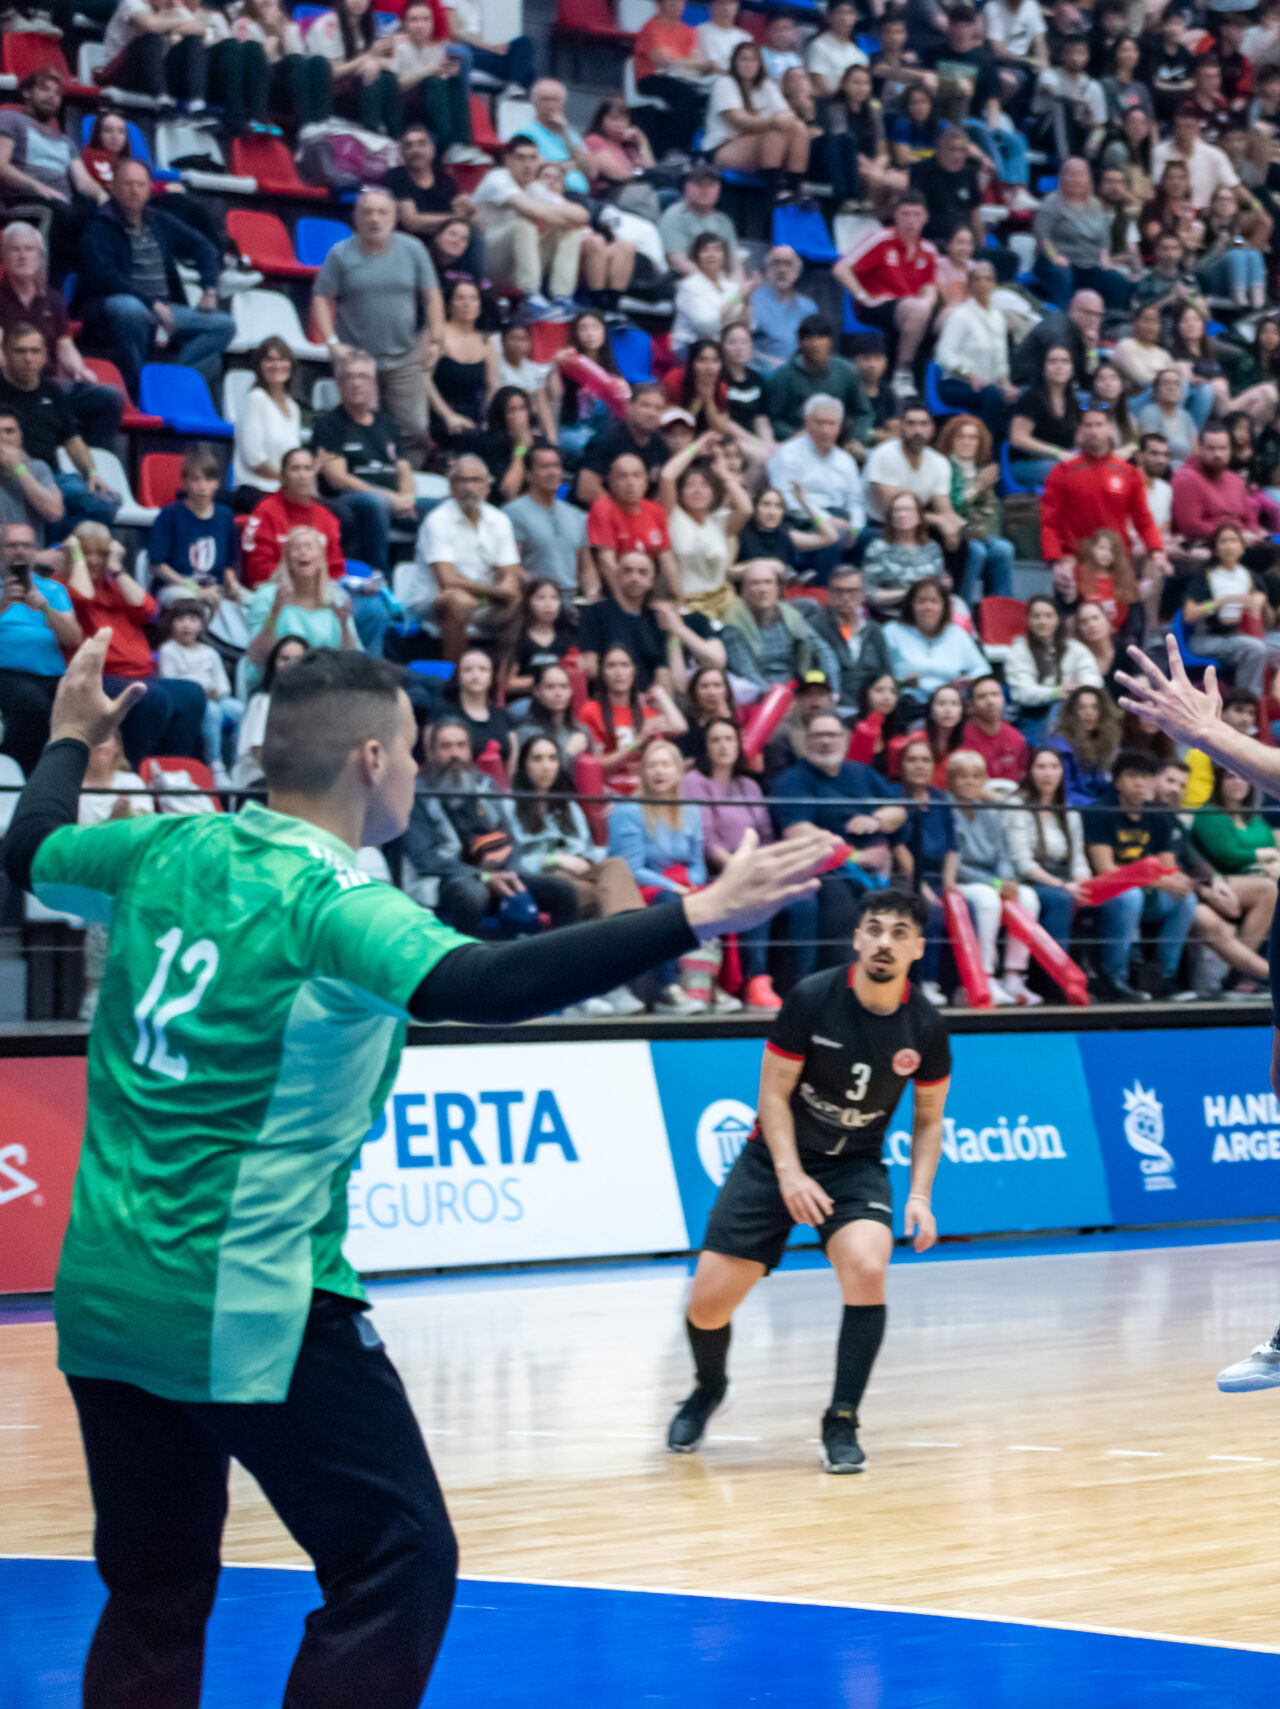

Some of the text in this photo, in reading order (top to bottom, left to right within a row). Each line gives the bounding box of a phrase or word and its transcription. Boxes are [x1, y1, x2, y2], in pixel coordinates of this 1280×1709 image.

[133, 927, 219, 1081] 12
[845, 1062, 872, 1101] 3
[942, 1114, 1067, 1164] Nación
